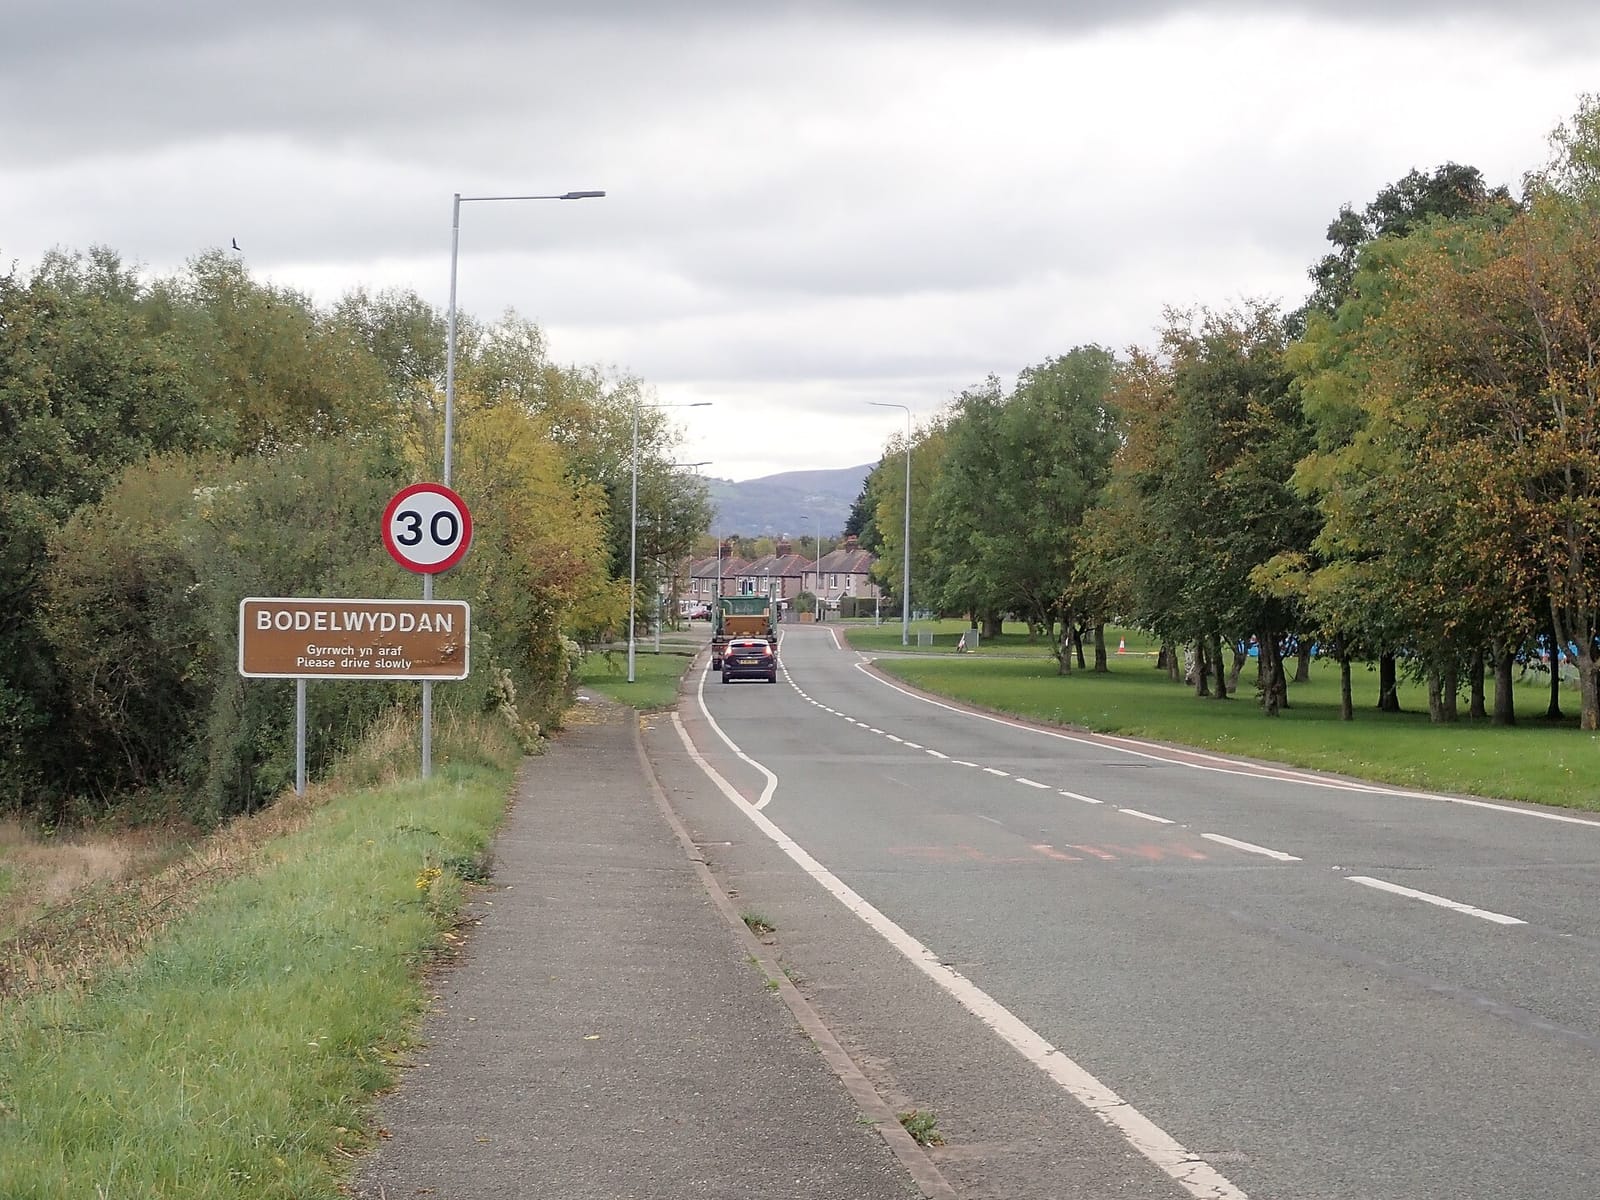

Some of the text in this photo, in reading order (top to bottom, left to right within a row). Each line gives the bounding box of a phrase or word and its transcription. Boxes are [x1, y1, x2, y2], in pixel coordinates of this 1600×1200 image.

[396, 510, 459, 546] 30
[256, 610, 453, 632] BODELWYDDAN
[306, 644, 403, 657] Gyrrwch yn araf
[296, 657, 412, 670] Please drive slowly
